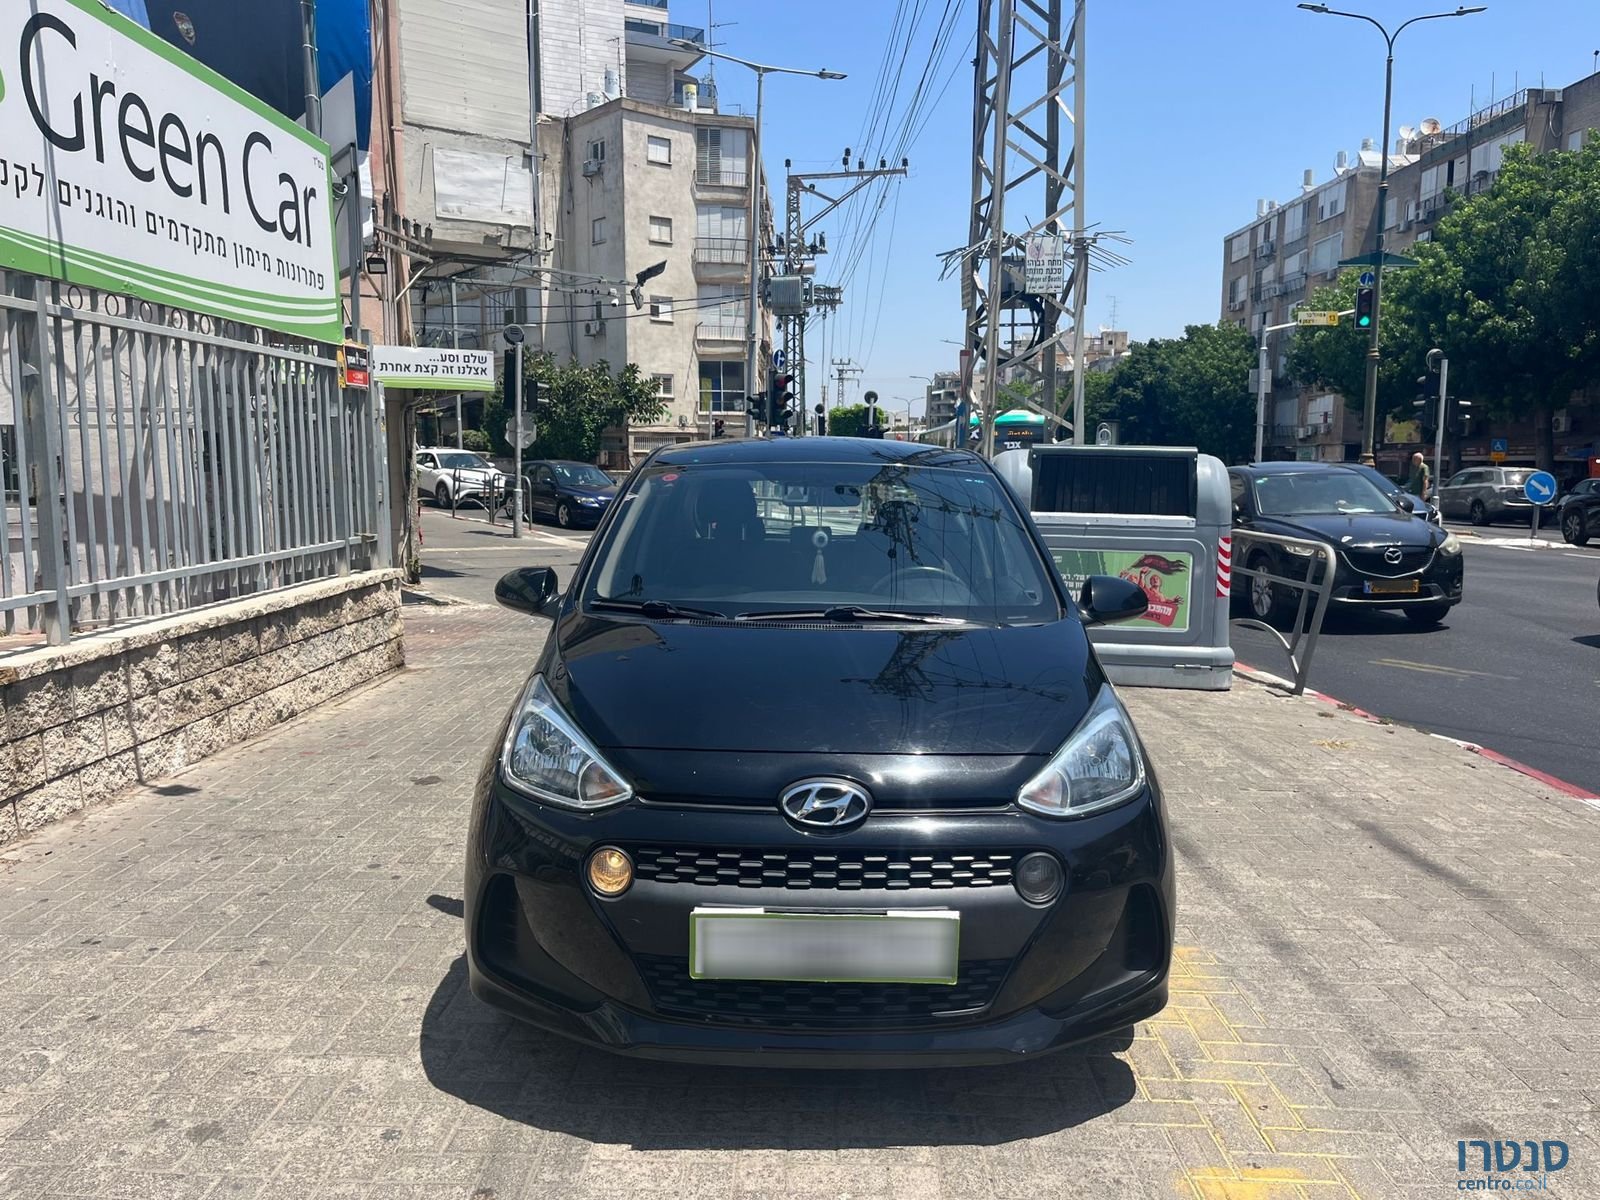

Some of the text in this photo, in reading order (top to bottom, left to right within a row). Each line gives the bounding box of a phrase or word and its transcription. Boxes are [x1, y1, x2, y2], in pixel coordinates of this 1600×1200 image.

[20, 12, 317, 248] Green Car
[57, 178, 136, 228] והוגנים
[145, 210, 227, 255] מתקדמים
[233, 242, 271, 273] מימון
[276, 258, 325, 291] פתרונות
[429, 353, 459, 363] וסע...
[463, 353, 487, 364] שלם
[380, 362, 411, 373] אחרת
[414, 363, 438, 376] קצת
[442, 364, 454, 374] זה
[457, 364, 488, 375] אצלנו
